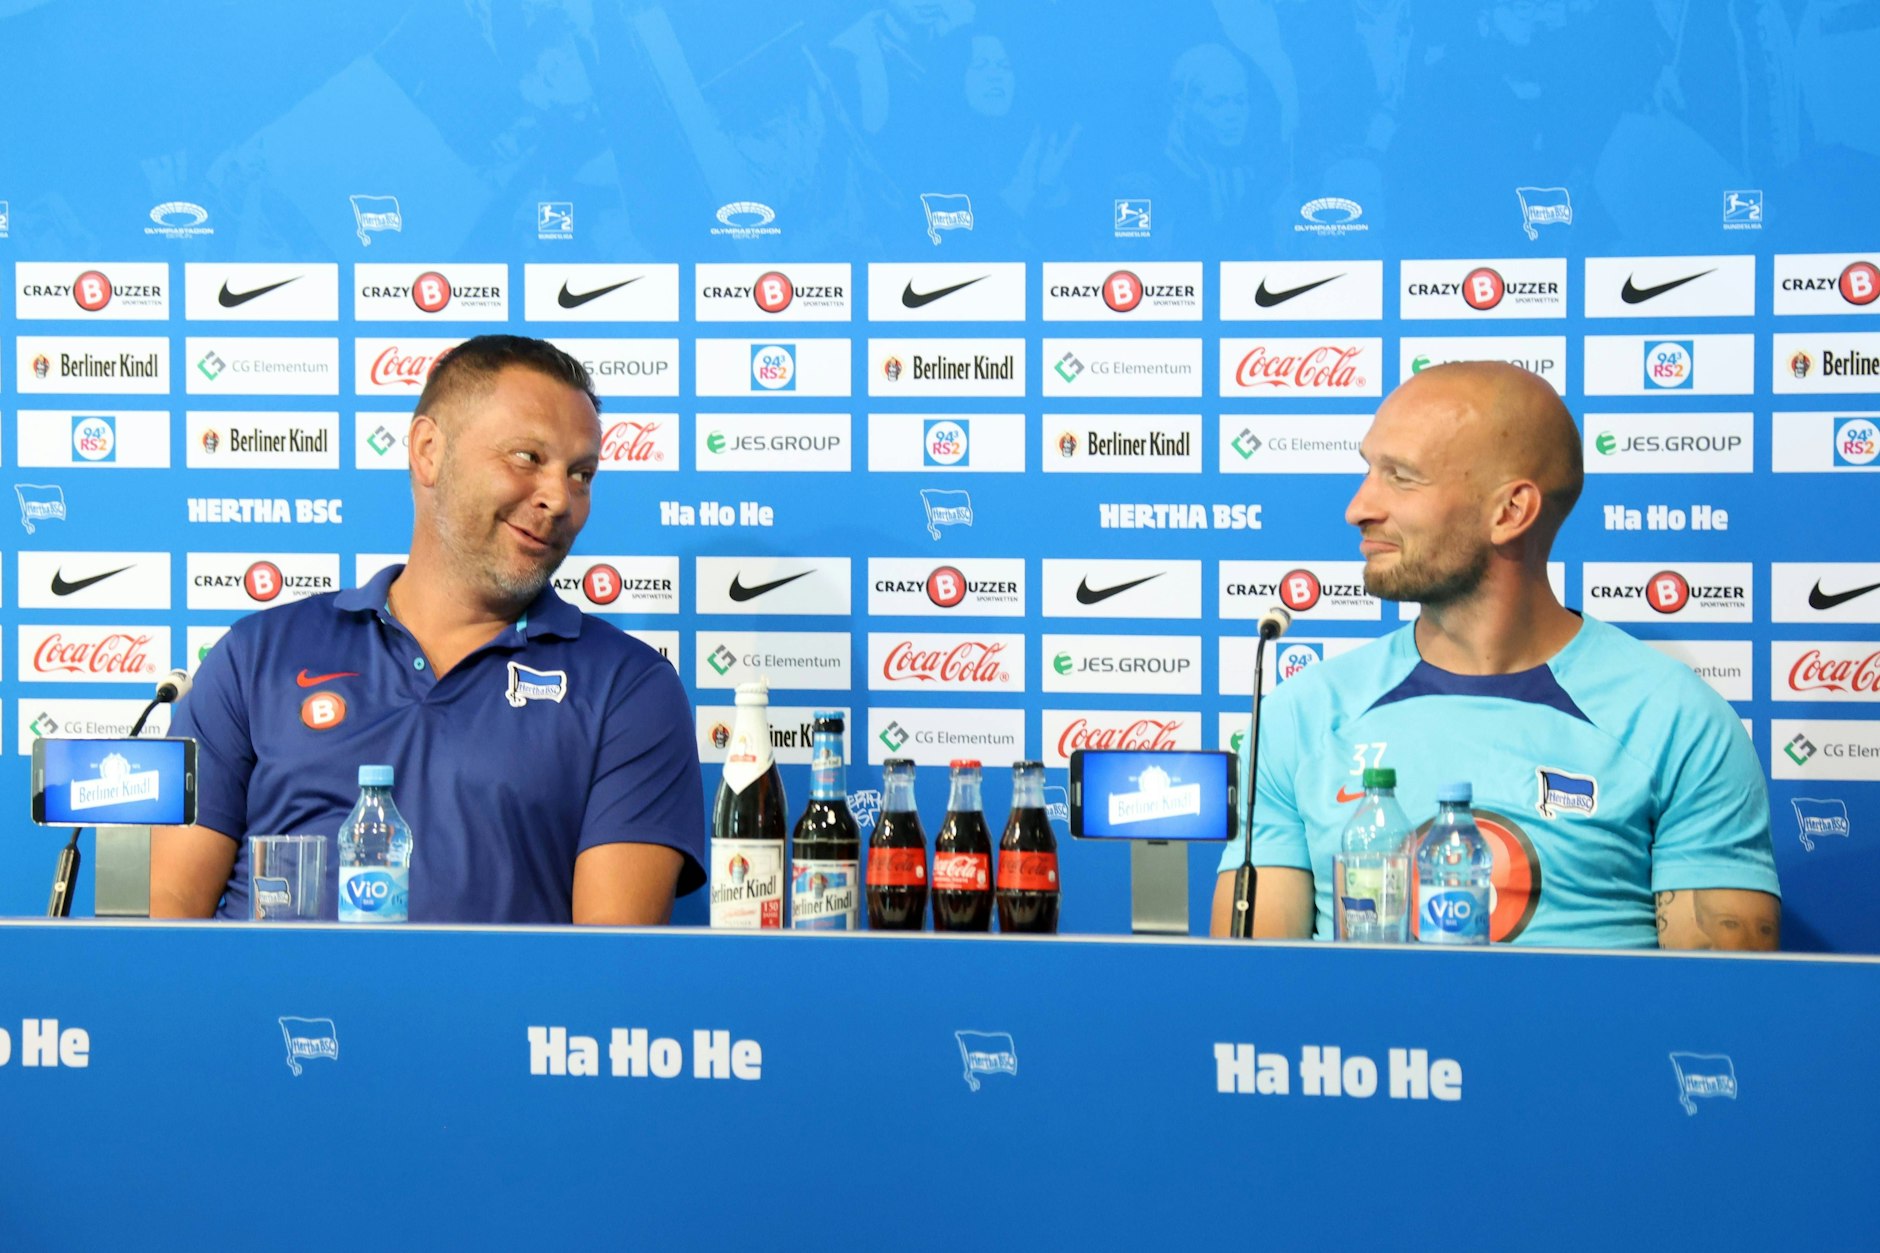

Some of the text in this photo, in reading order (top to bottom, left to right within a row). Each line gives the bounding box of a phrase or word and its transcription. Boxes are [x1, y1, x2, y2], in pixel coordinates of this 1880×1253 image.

[934, 212, 972, 226] Hertha BSC
[1529, 206, 1571, 219] Hertha BSC
[363, 214, 402, 227] Hertha BSC
[23, 285, 70, 297] CRAZY
[1050, 285, 1099, 298] CRAZY
[1408, 282, 1460, 296] CRAZY
[1782, 277, 1836, 291] CRAZY
[362, 286, 409, 298] CRAZY
[703, 286, 751, 299] CRAZY
[60, 353, 158, 378] Berliner Kindl
[232, 359, 329, 374] CG Elementum
[913, 355, 1014, 380] Berliner Kindl
[1091, 360, 1191, 375] CG Elementum
[1235, 345, 1363, 388] Coca-Cola
[1654, 364, 1682, 377] RS2
[1823, 350, 1880, 376] Berline
[760, 367, 786, 379] RS2
[80, 439, 107, 451] RS2
[230, 428, 328, 453] Berliner Kindl
[730, 435, 840, 451] JES.GROUP
[1088, 432, 1190, 456] Berliner Kindl
[1269, 438, 1288, 451] CG
[1622, 436, 1741, 452] JES.GROUP
[1844, 441, 1873, 454] RS2
[932, 442, 960, 455] RS2
[188, 498, 343, 524] HERTHA BSC
[661, 501, 773, 526] Ha Ho He
[933, 508, 970, 521] Hertha BSC
[1099, 503, 1262, 530] HERTHA BSC
[1604, 505, 1728, 530] Ha Ho He
[195, 576, 241, 588] CRAZY
[553, 578, 582, 590] AZY
[876, 580, 924, 593] CRAZY
[1227, 583, 1277, 596] CRAZY
[1591, 585, 1643, 599] CRAZY
[34, 633, 152, 674] Coca-Cola
[884, 640, 1008, 682] Coca-Cola
[743, 654, 841, 669] CG Elementum
[1077, 657, 1190, 673] JES.GROUP
[519, 682, 560, 697] Hertha BSC
[312, 698, 334, 725] B
[65, 721, 83, 734] CG
[915, 730, 1014, 745] CG Elementum
[1824, 743, 1844, 757] CG
[1350, 743, 1387, 776] 37
[1550, 789, 1592, 808] Hertha BSC
[1806, 817, 1848, 832] Hertha BSC
[350, 880, 387, 898] ViO
[747, 875, 776, 898] Kindl
[826, 891, 852, 912] Kindl
[1432, 901, 1469, 919] ViO
[22, 1018, 90, 1067] He
[293, 1039, 336, 1054] Hertha BSC
[528, 1026, 762, 1080] Ha Ho He
[1214, 1043, 1462, 1100] Ha Ho He
